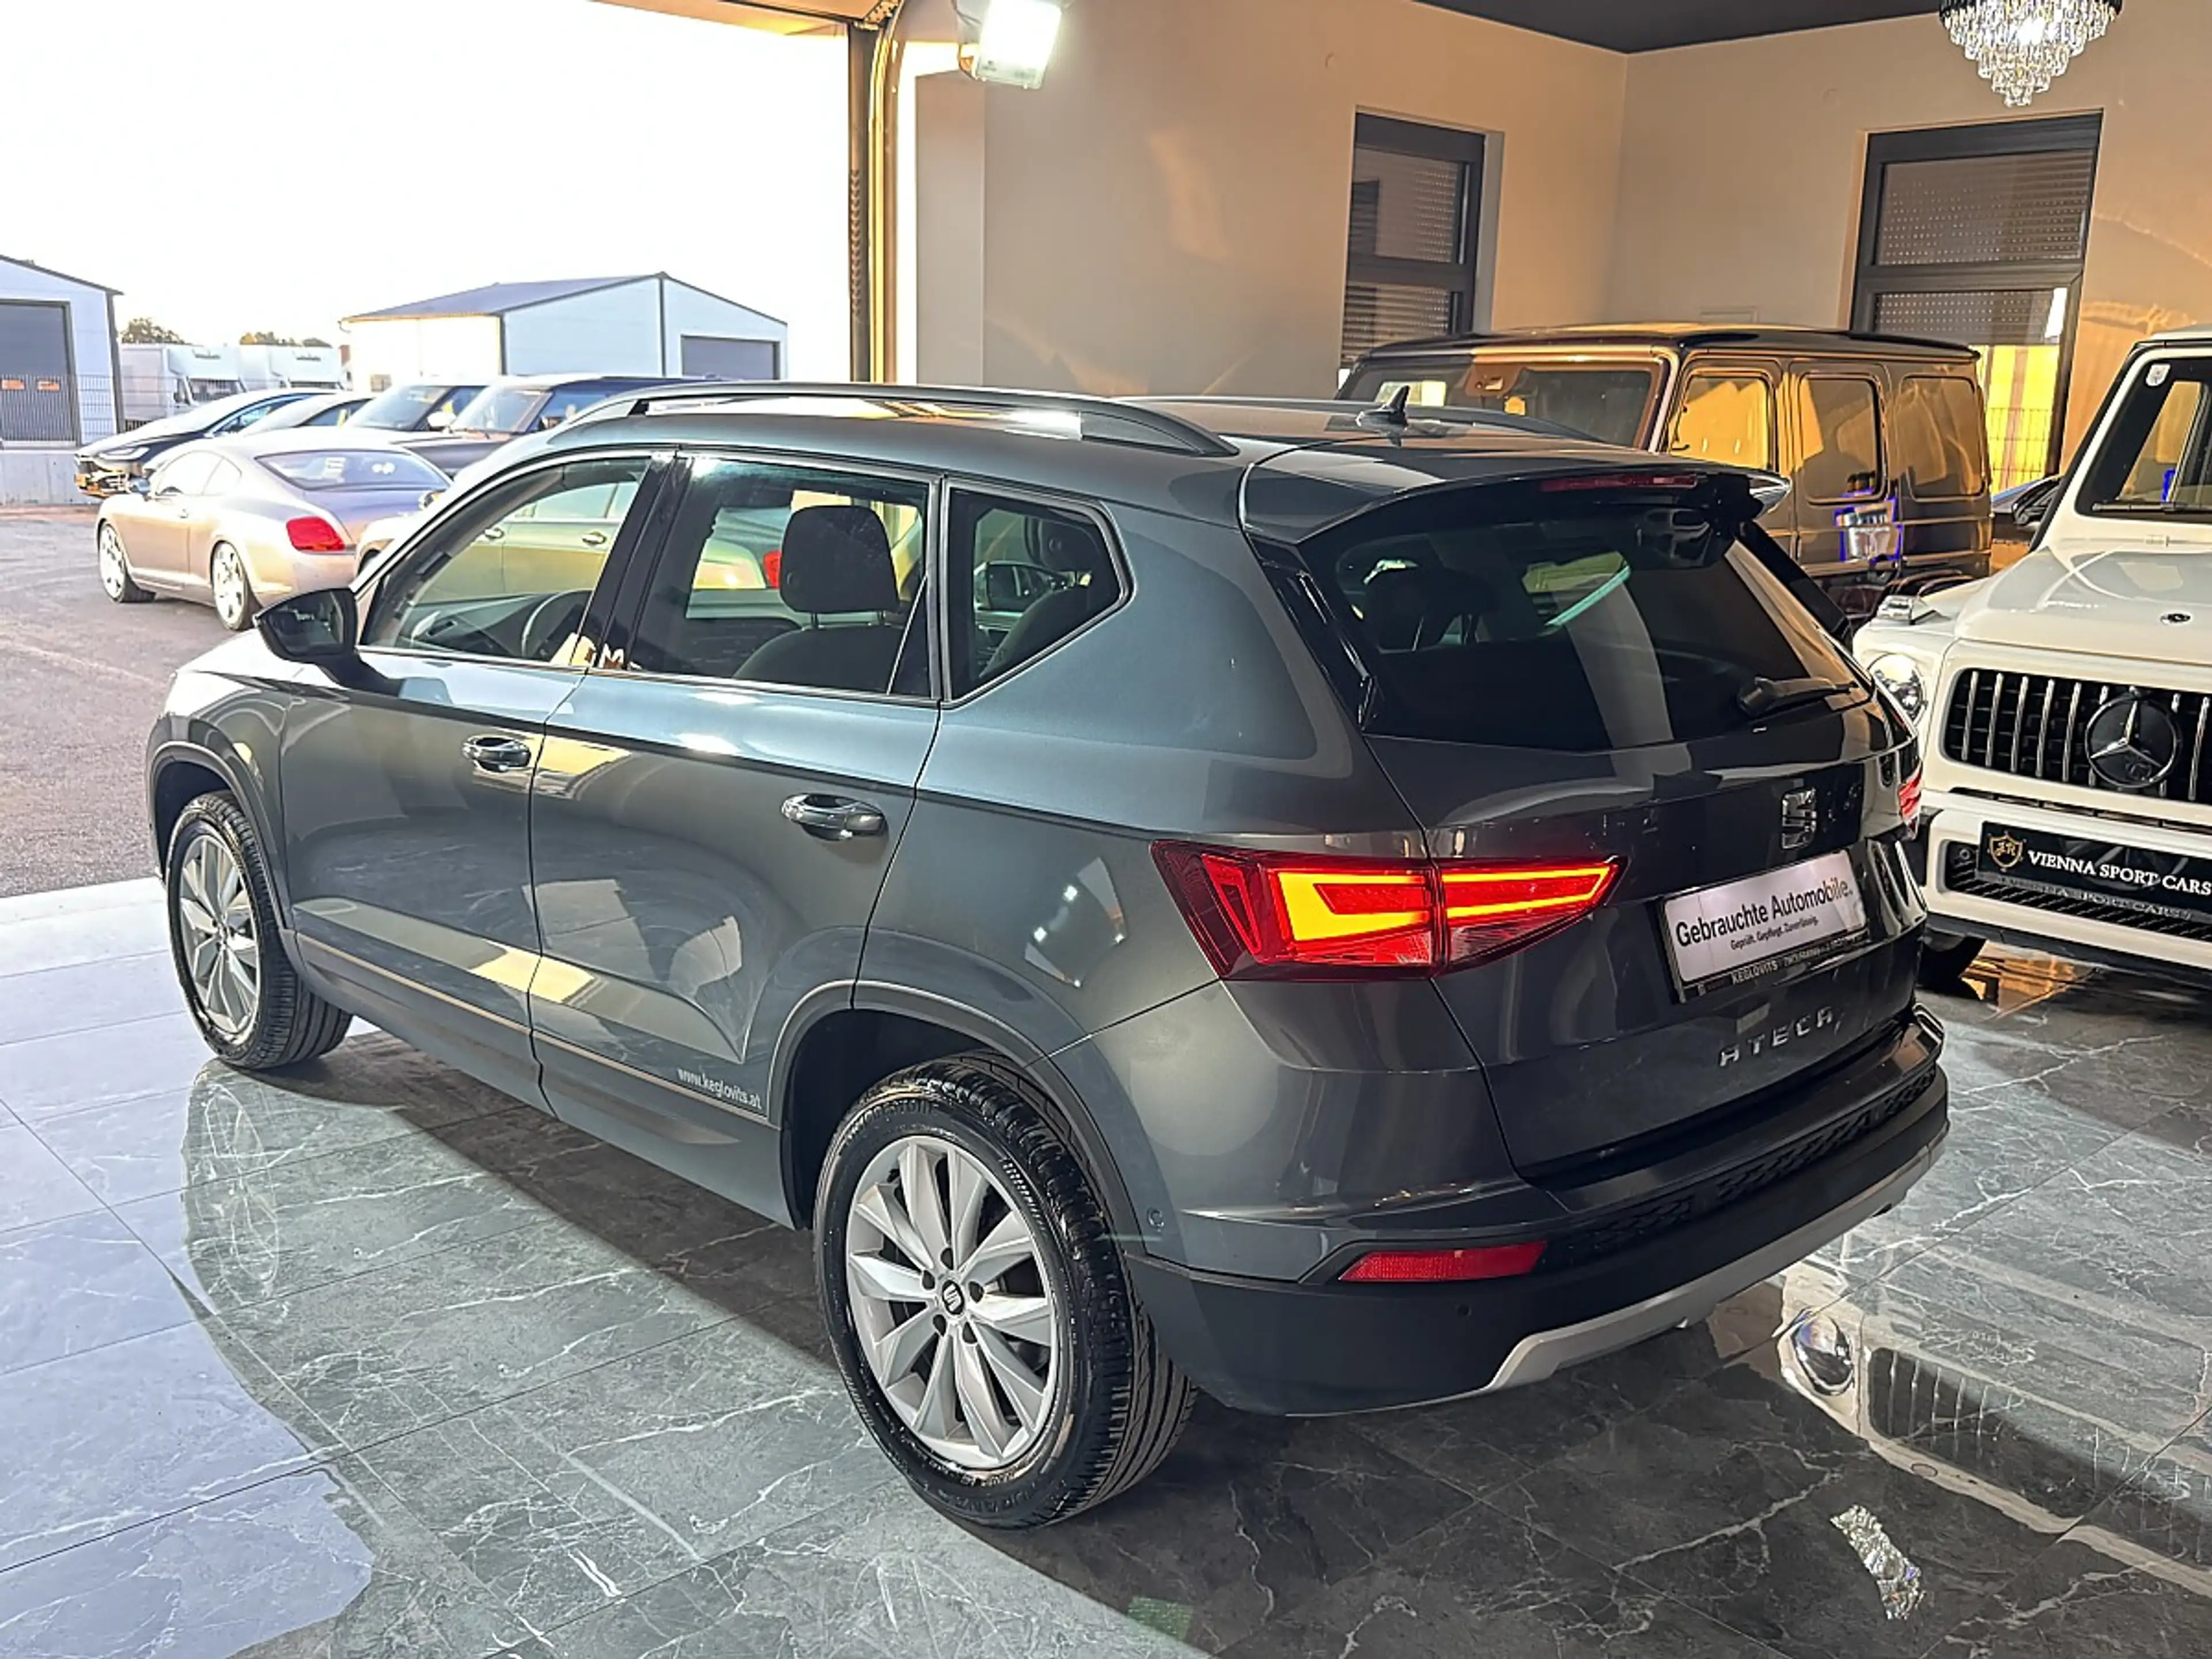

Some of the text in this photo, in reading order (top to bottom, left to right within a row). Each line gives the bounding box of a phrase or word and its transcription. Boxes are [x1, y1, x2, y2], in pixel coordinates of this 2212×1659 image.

[2028, 850, 2212, 896] VIENNA SPORT CARS
[1675, 877, 1853, 947] Gebrauchte Automobile.
[1719, 1006, 1833, 1067] ATECA
